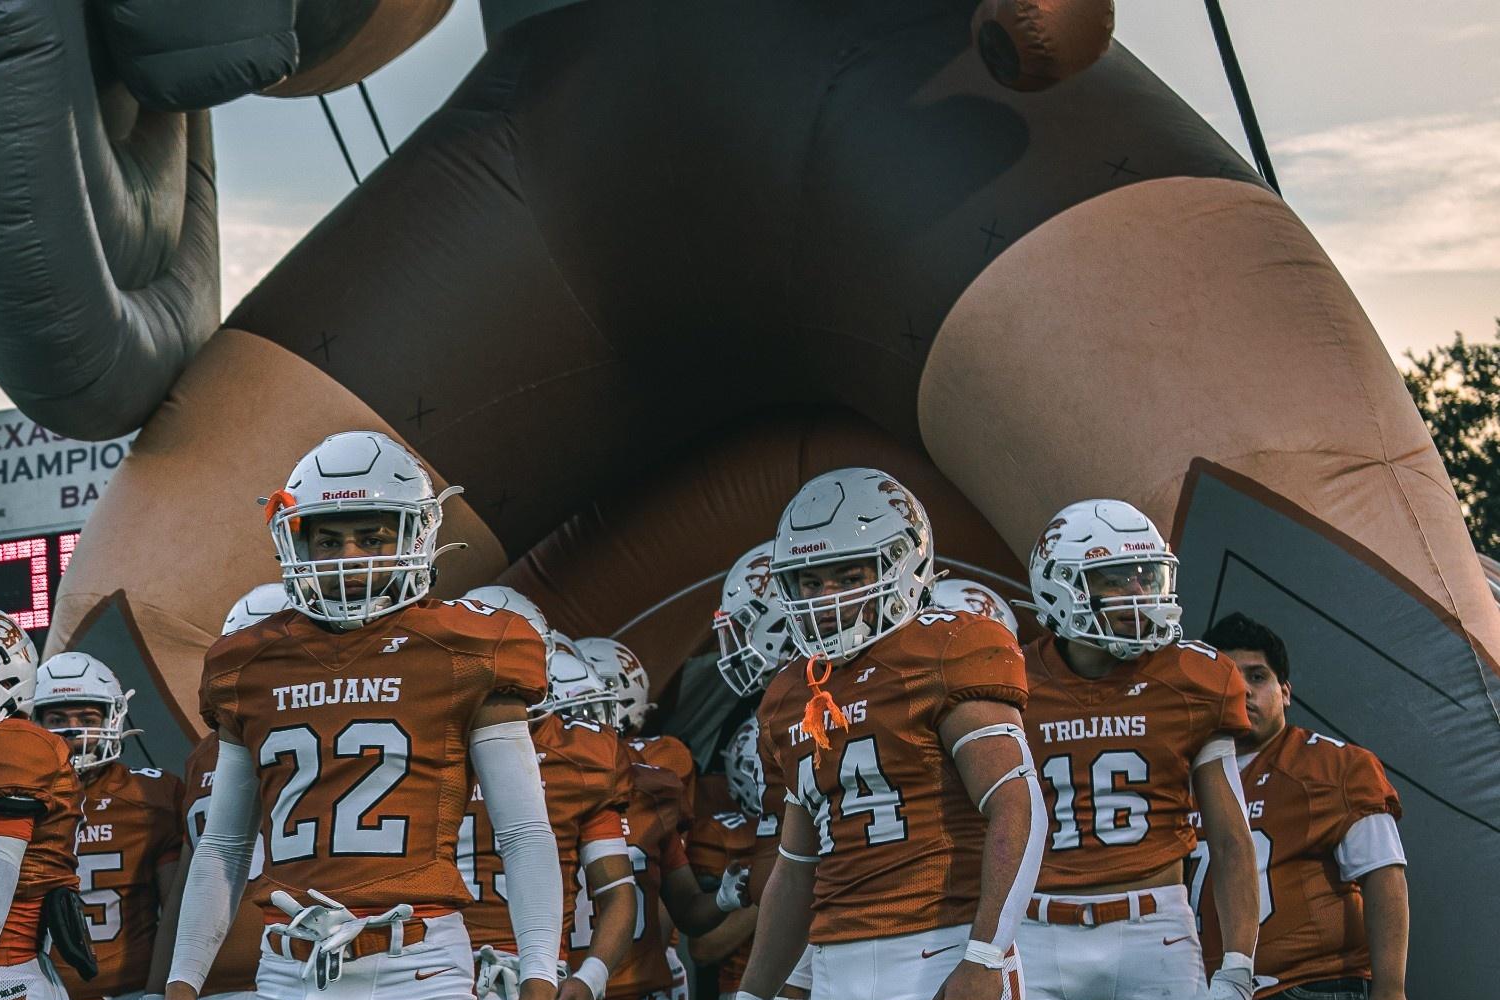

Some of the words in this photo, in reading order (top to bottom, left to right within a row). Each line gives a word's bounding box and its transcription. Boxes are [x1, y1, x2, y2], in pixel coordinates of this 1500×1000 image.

[61, 480, 108, 509] BA
[322, 490, 366, 500] Riddell
[791, 542, 827, 555] Riddell
[272, 677, 402, 711] TROJANS
[1039, 715, 1146, 743] TROJANS
[259, 718, 411, 866] 22
[797, 734, 909, 857] 44
[1041, 749, 1151, 851] 16
[75, 849, 124, 942] 5
